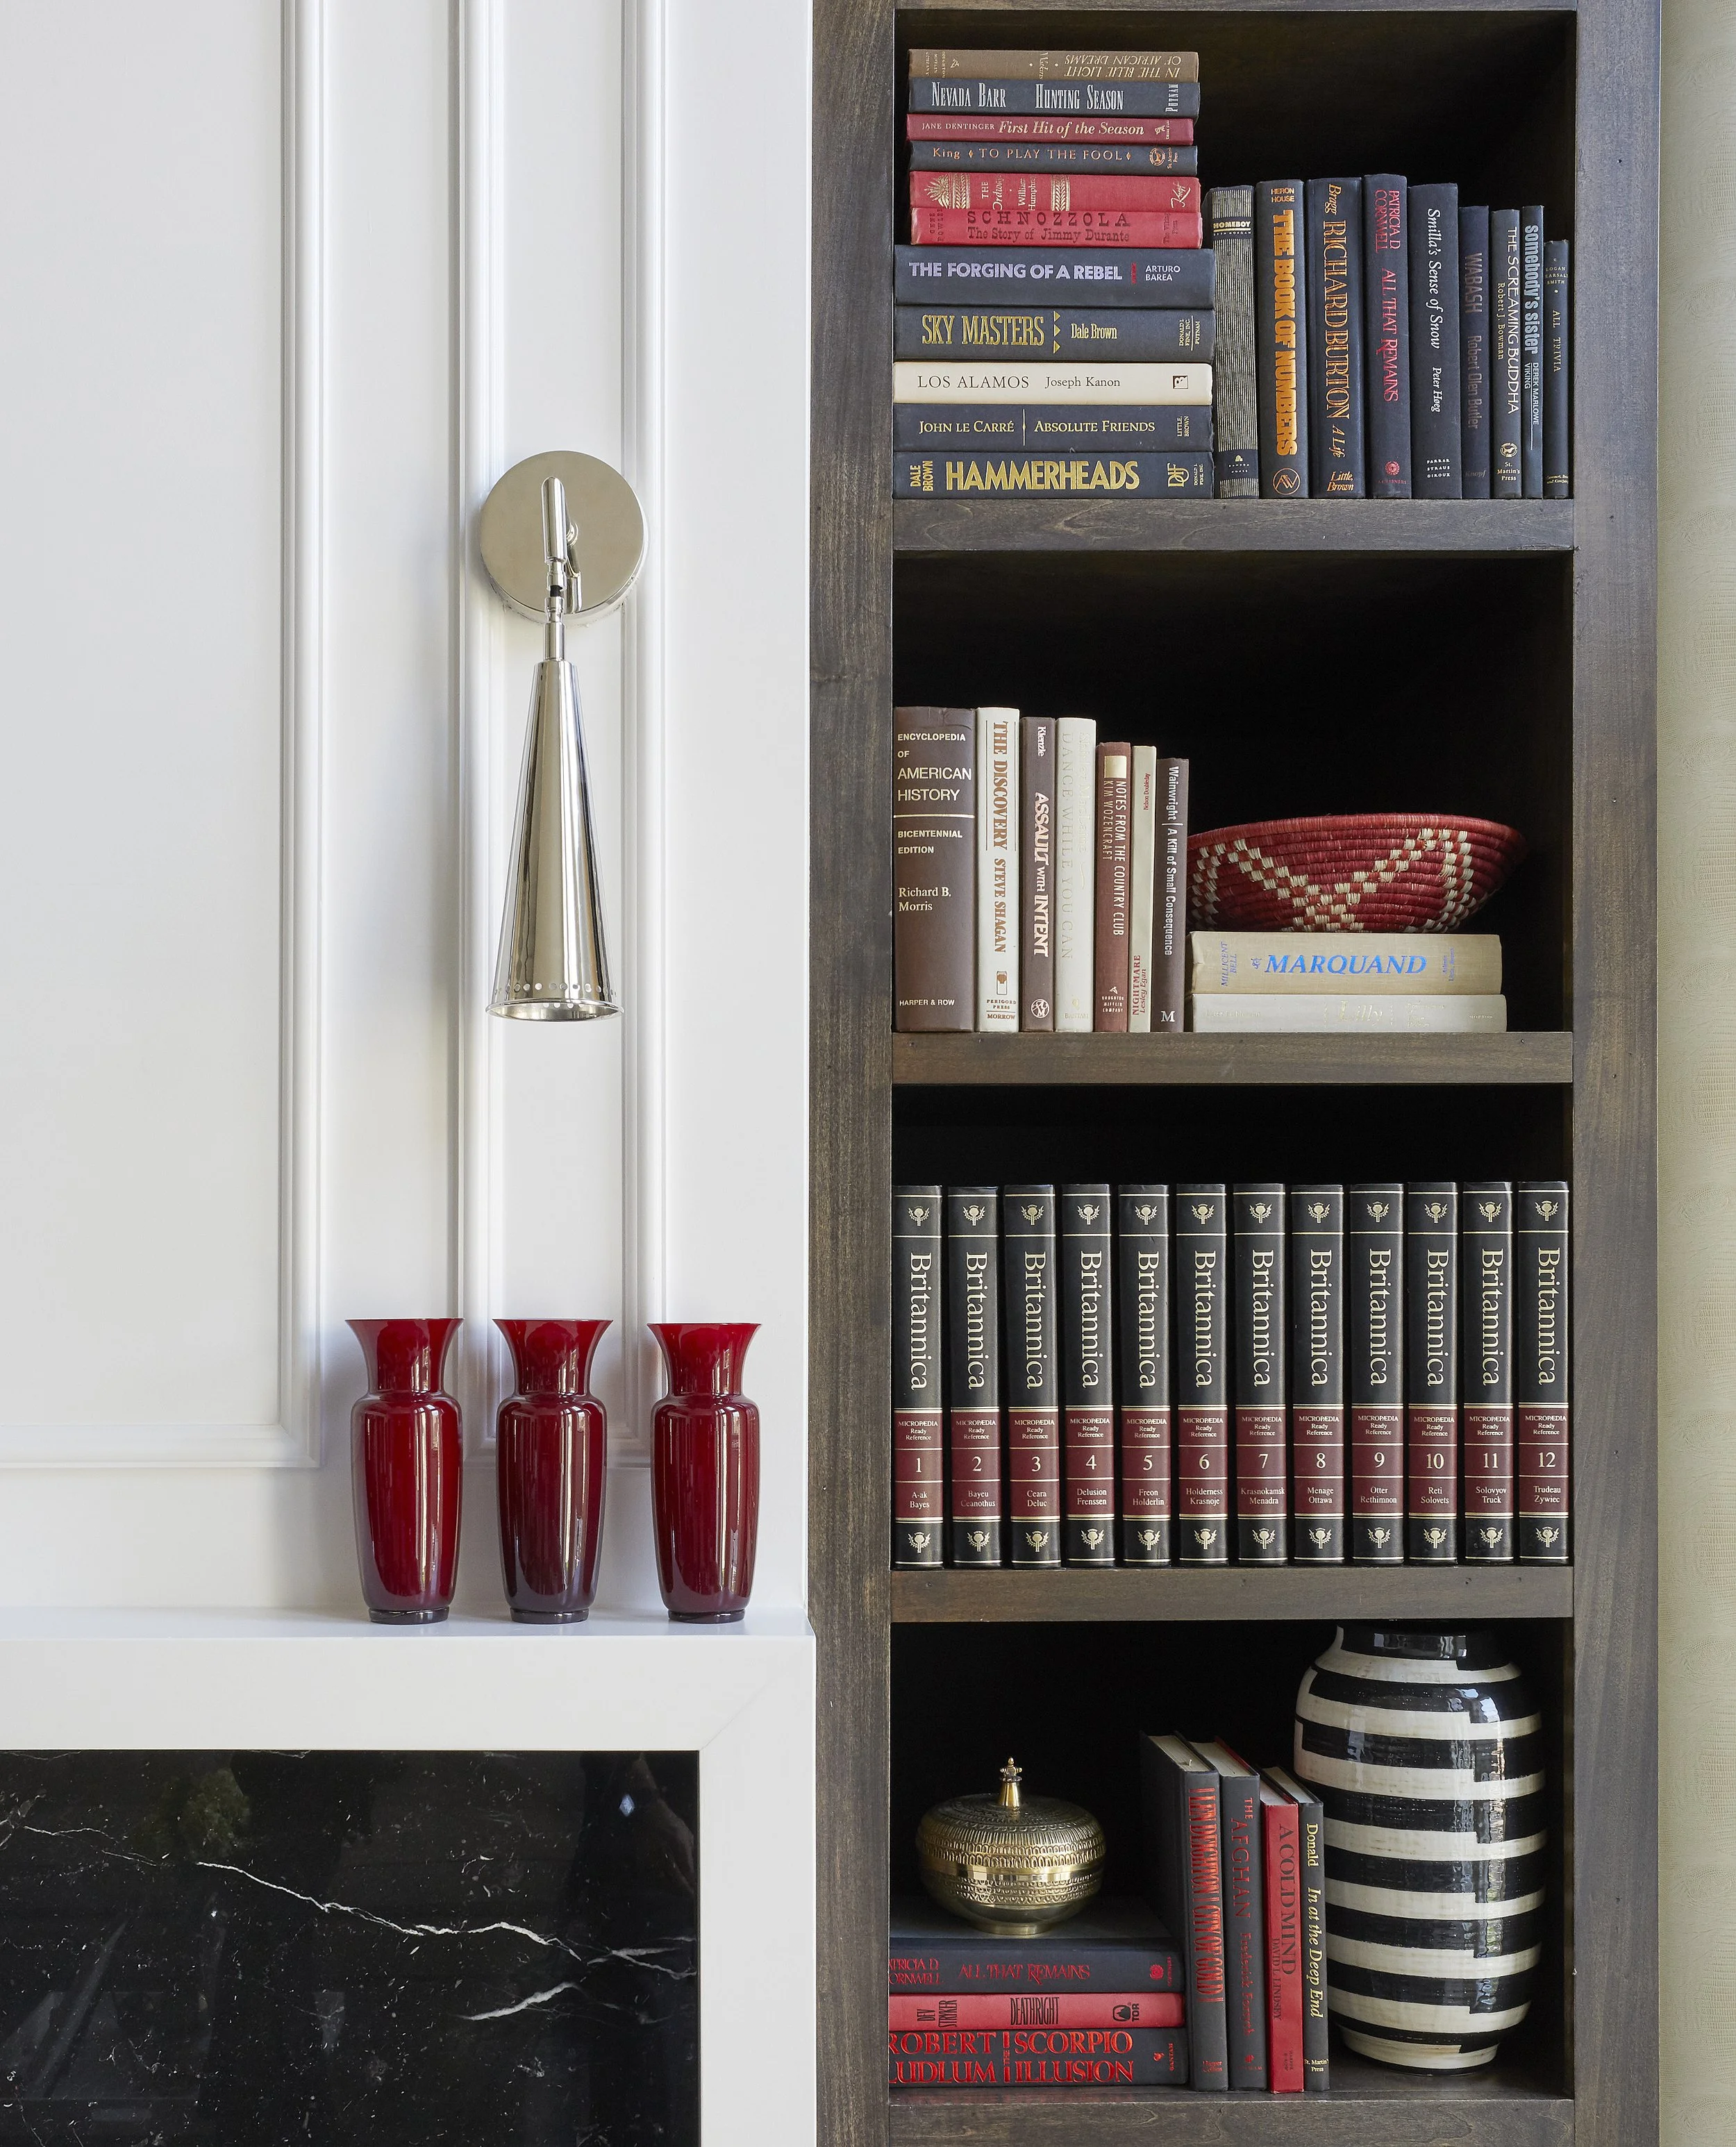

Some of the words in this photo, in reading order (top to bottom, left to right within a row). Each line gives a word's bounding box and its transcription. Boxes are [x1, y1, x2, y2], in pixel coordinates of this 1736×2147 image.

[1065, 66, 1103, 77] LIGHT
[1108, 66, 1132, 78] BLUE
[1137, 67, 1160, 78] THE
[1165, 67, 1180, 78] IN
[998, 121, 1028, 134] First
[1033, 122, 1054, 134] Hit
[1057, 121, 1072, 138] of
[1076, 122, 1095, 135] the
[1099, 122, 1144, 135] Season
[933, 148, 960, 160] King
[979, 148, 999, 158] TO
[1007, 149, 1040, 160] PLAY
[1047, 149, 1076, 160] THE
[1083, 150, 1122, 160] FOOL
[967, 211, 1130, 227] SCHNOZZOLA
[1428, 208, 1440, 256] Smilla's
[967, 228, 989, 240] The
[992, 228, 1021, 243] Story
[1024, 228, 1034, 240] of
[1041, 228, 1081, 244] Jimmy
[1085, 229, 1130, 242] Durante
[1272, 210, 1294, 256] THE
[1508, 227, 1517, 253] THE
[909, 262, 942, 276] THE
[947, 262, 1026, 278] FORGING
[1030, 264, 1053, 279] OF
[1055, 265, 1070, 279] A
[1074, 265, 1122, 280] REBEL
[1324, 220, 1349, 328] RICHARD
[1382, 268, 1395, 294] ALL
[1429, 260, 1439, 294] Sense
[1274, 259, 1295, 319] BOOK
[1508, 256, 1519, 344] SCREAMING
[1381, 301, 1397, 335] THAT
[1426, 299, 1439, 312] of
[922, 315, 955, 344] SKY
[962, 316, 1044, 345] MASTERS
[1071, 324, 1089, 339] Dale
[1091, 325, 1117, 340] Brown
[1275, 322, 1296, 348] OF
[1430, 314, 1440, 349] Snow
[1525, 312, 1538, 354] sister
[917, 376, 951, 388] LOS
[957, 376, 1029, 388] ALAMOS
[1045, 376, 1081, 389] Joseph
[1086, 376, 1120, 387] Kanon
[1325, 330, 1349, 419] BURTON
[1376, 339, 1399, 401] REMAINS
[1433, 367, 1441, 389] Peter
[1508, 347, 1519, 414] BUDDHA
[1276, 351, 1298, 456] NUMBERS
[1431, 390, 1441, 412] Høeg
[946, 460, 1140, 490] HAMMERHEADS
[993, 721, 1008, 755] THE
[898, 768, 971, 780] AMERICAN
[898, 789, 960, 801] HISTORY
[993, 760, 1008, 850] DISCOVERY
[1115, 781, 1127, 810] NOTES
[1167, 766, 1179, 821] Wainwright
[1035, 792, 1049, 866] ASSAULT
[1115, 814, 1126, 839] FROM
[1115, 842, 1126, 860] THE
[1167, 838, 1177, 854] Kill
[994, 858, 1005, 898] STEVE
[1114, 864, 1126, 911] COUNTRY
[1167, 864, 1176, 893] Small
[899, 887, 939, 898] Richard
[942, 887, 951, 897] B.
[899, 901, 933, 911] Morris
[994, 901, 1005, 952] SHAGAN
[1034, 895, 1049, 957] INTENT
[1113, 914, 1124, 935] CLUB
[1164, 896, 1176, 956] Consequence
[1265, 955, 1427, 974] MARQUAND
[910, 1252, 932, 1390] Britannica
[966, 1252, 988, 1390] Britannica
[1024, 1251, 1046, 1389] Britannica
[1080, 1251, 1103, 1388] Britannica
[1137, 1251, 1160, 1388] Britannica
[1194, 1251, 1217, 1388] Britannica
[1252, 1249, 1275, 1387] Britannica
[1310, 1249, 1333, 1386] Britannica
[1369, 1248, 1392, 1386] Britannica
[1426, 1249, 1449, 1386] Britannica
[1481, 1248, 1504, 1385] Britannica
[1538, 1247, 1560, 1385] Britannica
[916, 1457, 921, 1473] 1
[972, 1456, 982, 1471] 2
[1031, 1456, 1041, 1471] 3
[1085, 1455, 1096, 1469] 4
[1143, 1455, 1153, 1470] 5
[1199, 1454, 1210, 1469] 6
[1258, 1453, 1268, 1469] 7
[1317, 1453, 1326, 1468] 8
[1374, 1452, 1385, 1467] 9
[1426, 1453, 1444, 1469] 10
[1483, 1453, 1498, 1468] 11
[1538, 1453, 1555, 1467] 12
[1279, 1824, 1294, 1839] A
[1306, 1823, 1318, 1866] Donald
[1230, 1818, 1251, 1917] AFGHAN
[1278, 1844, 1295, 1907] COLD
[1308, 1888, 1321, 1904] In
[1309, 1907, 1319, 1920] at
[1280, 1913, 1296, 1975] MIND
[1308, 1923, 1319, 1946] the
[1308, 1948, 1323, 1984] Deep
[1010, 1997, 1060, 2025] DEATHRIGHT
[1131, 2003, 1140, 2021] TOR
[1310, 1986, 1324, 2017] End
[889, 2032, 996, 2055] ROBERT
[1014, 2031, 1133, 2054] SCORPIO
[1015, 2061, 1133, 2082] ILLUSION
